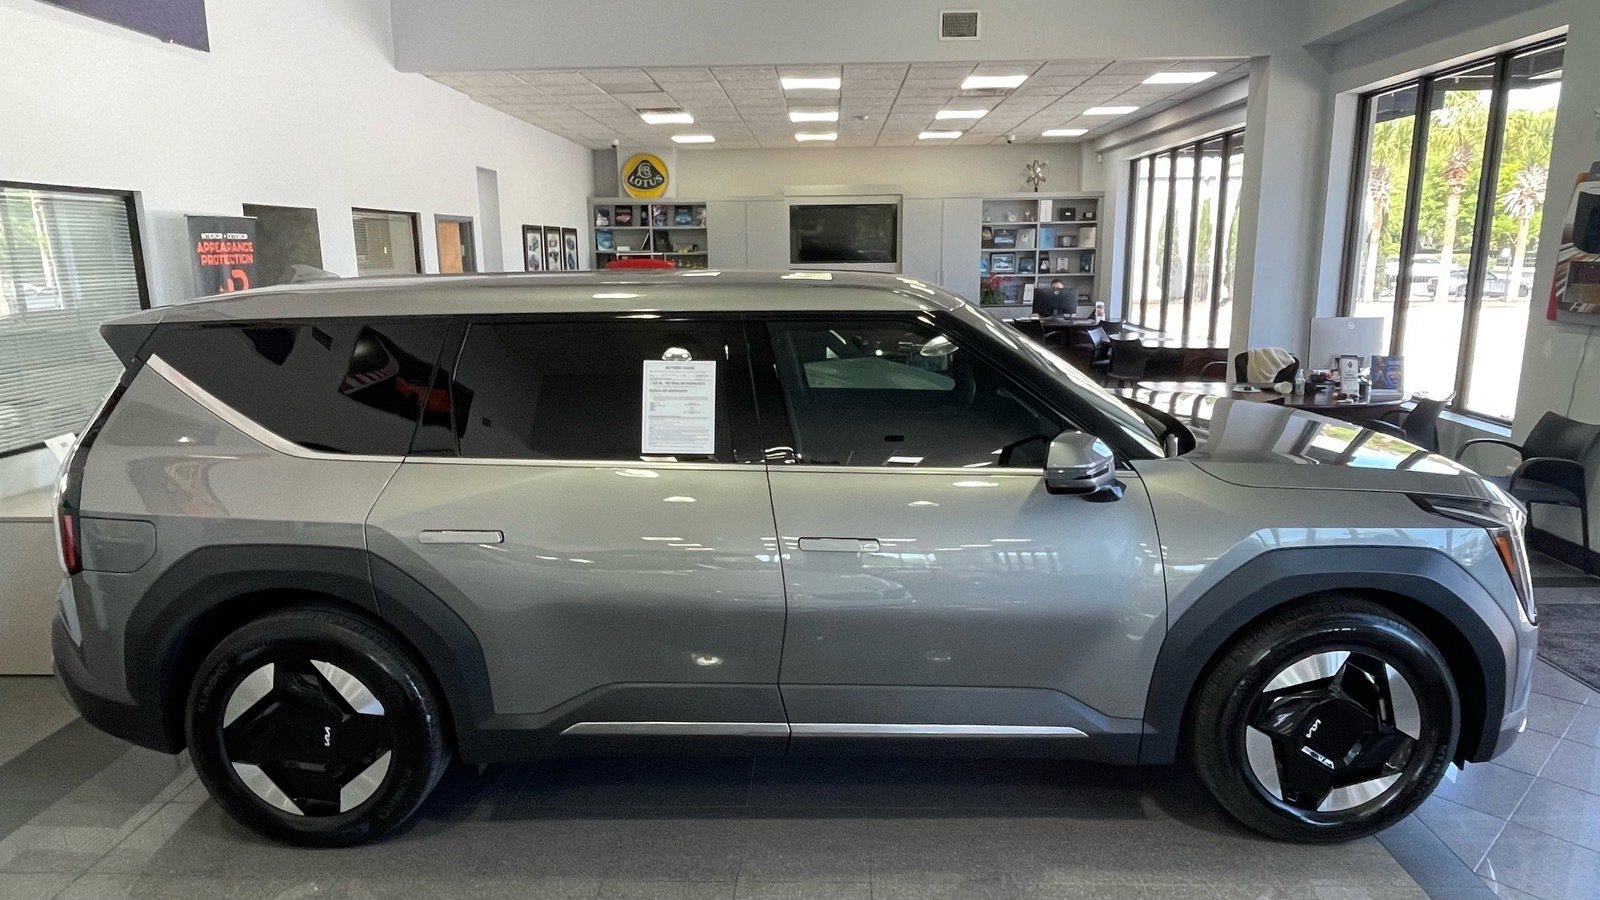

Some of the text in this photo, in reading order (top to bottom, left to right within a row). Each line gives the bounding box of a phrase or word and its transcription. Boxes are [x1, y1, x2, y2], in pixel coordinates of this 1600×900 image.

[629, 174, 662, 187] LOTUS
[198, 242, 254, 253] APPEARANCE
[202, 254, 254, 265] PROTECTION
